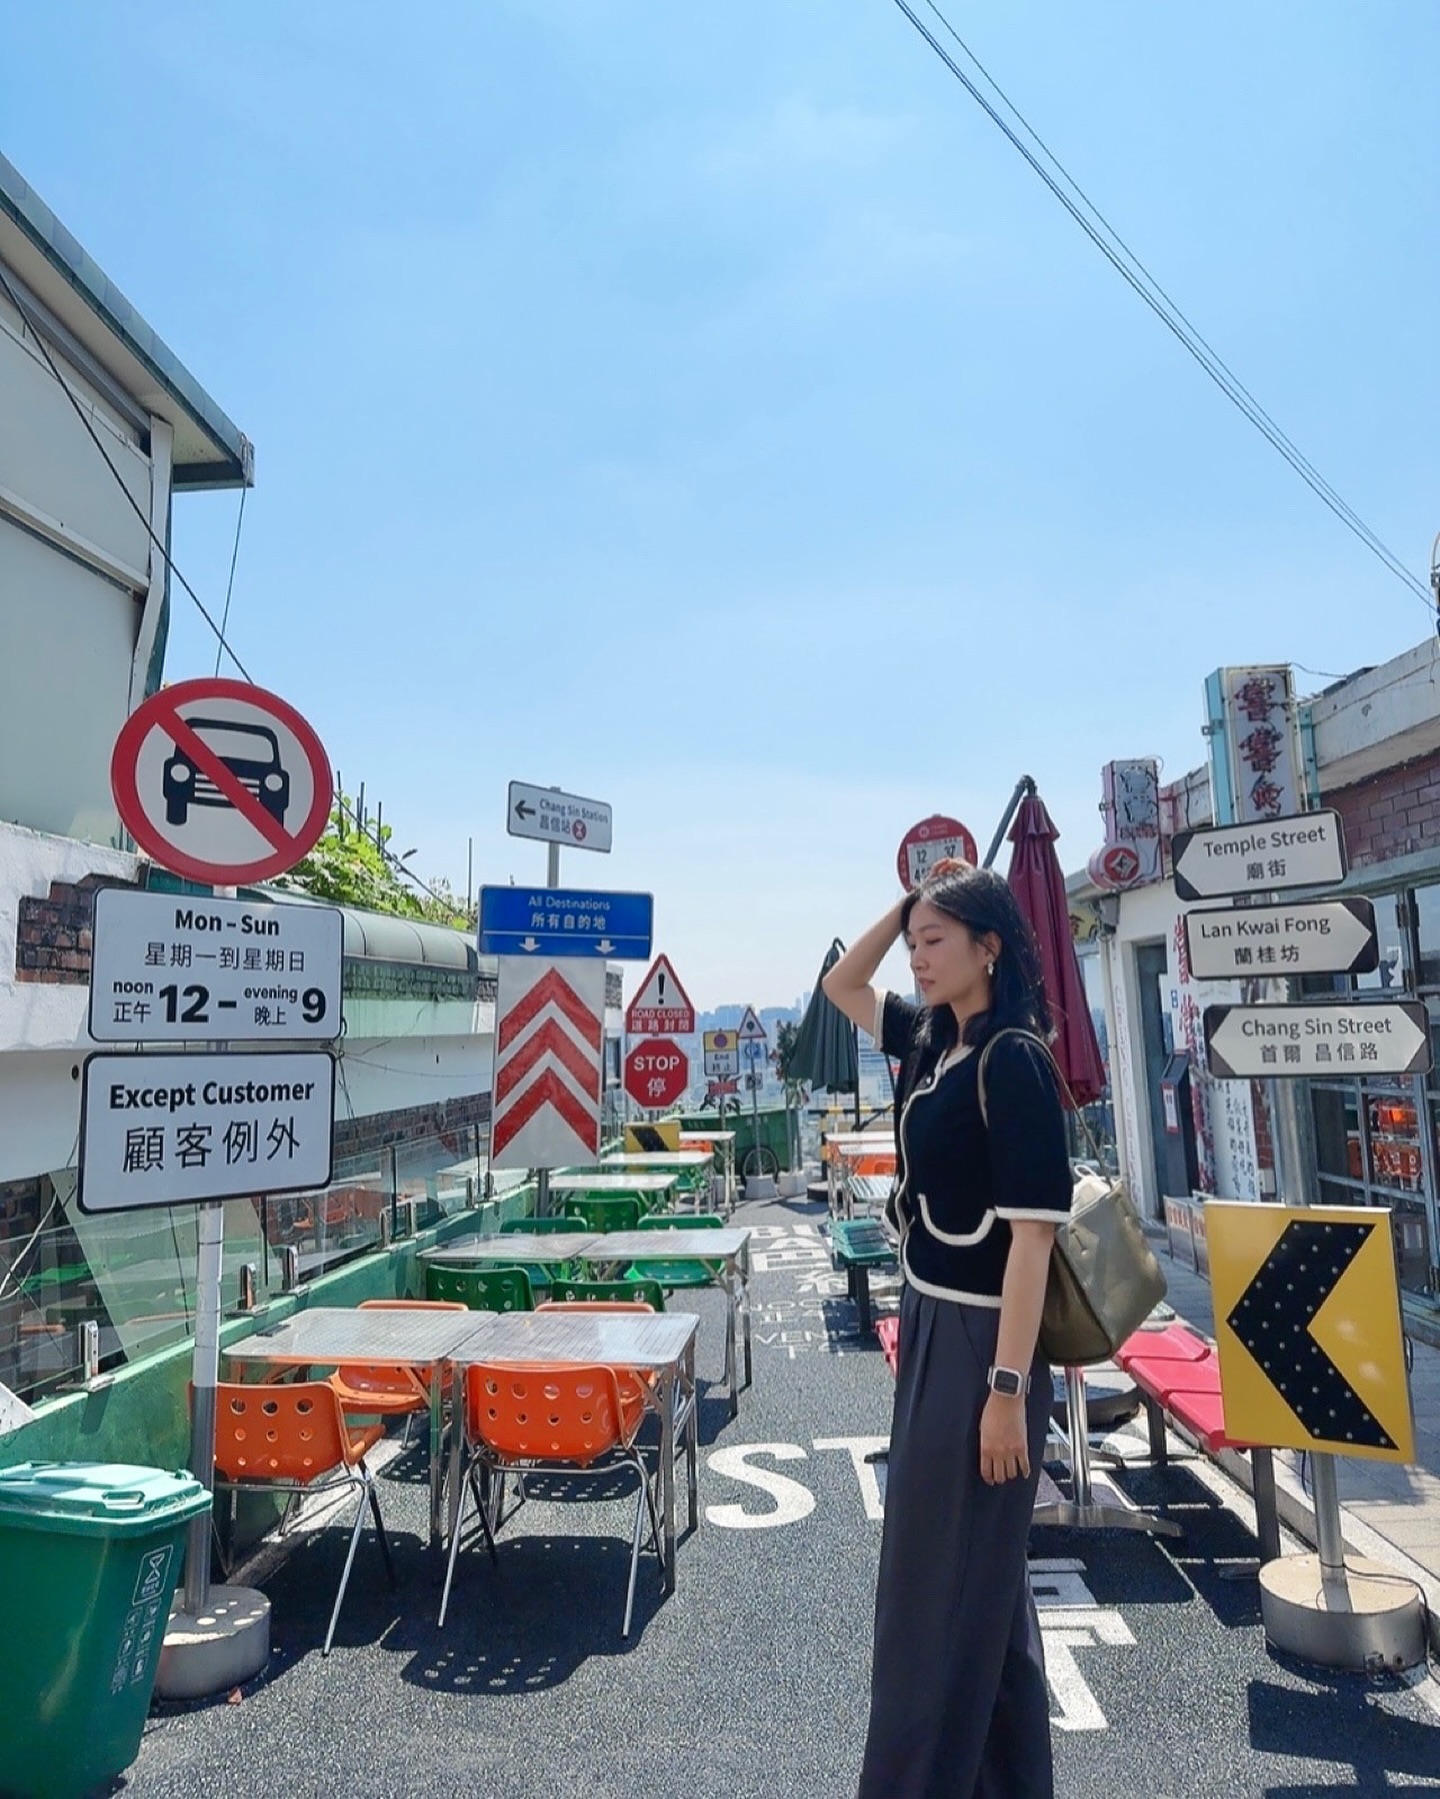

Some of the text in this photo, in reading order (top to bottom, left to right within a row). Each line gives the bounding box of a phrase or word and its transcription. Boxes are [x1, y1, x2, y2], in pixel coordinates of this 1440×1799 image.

[540, 798, 608, 824] Chang Sin Station
[1203, 825, 1327, 857] Temple Street
[1246, 858, 1287, 881] 廟街
[528, 895, 611, 911] All Destinations
[1201, 917, 1331, 939] Lan Kwai Fong
[144, 941, 306, 972] 星期一到星期日
[1234, 944, 1300, 966] 蘭桂坊
[113, 981, 154, 994] noon
[159, 984, 210, 1024] 12
[244, 984, 298, 1003] evening
[302, 987, 327, 1024] 9
[113, 1001, 152, 1024] 正午
[631, 1009, 690, 1019] ROAD CLOSED
[254, 1005, 287, 1026] 晚上
[1242, 1017, 1393, 1040] Chang Sin Street
[633, 1055, 680, 1071] STOP
[109, 1080, 315, 1113] Except Customer
[647, 1076, 667, 1098] 停
[122, 1115, 300, 1174] 顧客例外
